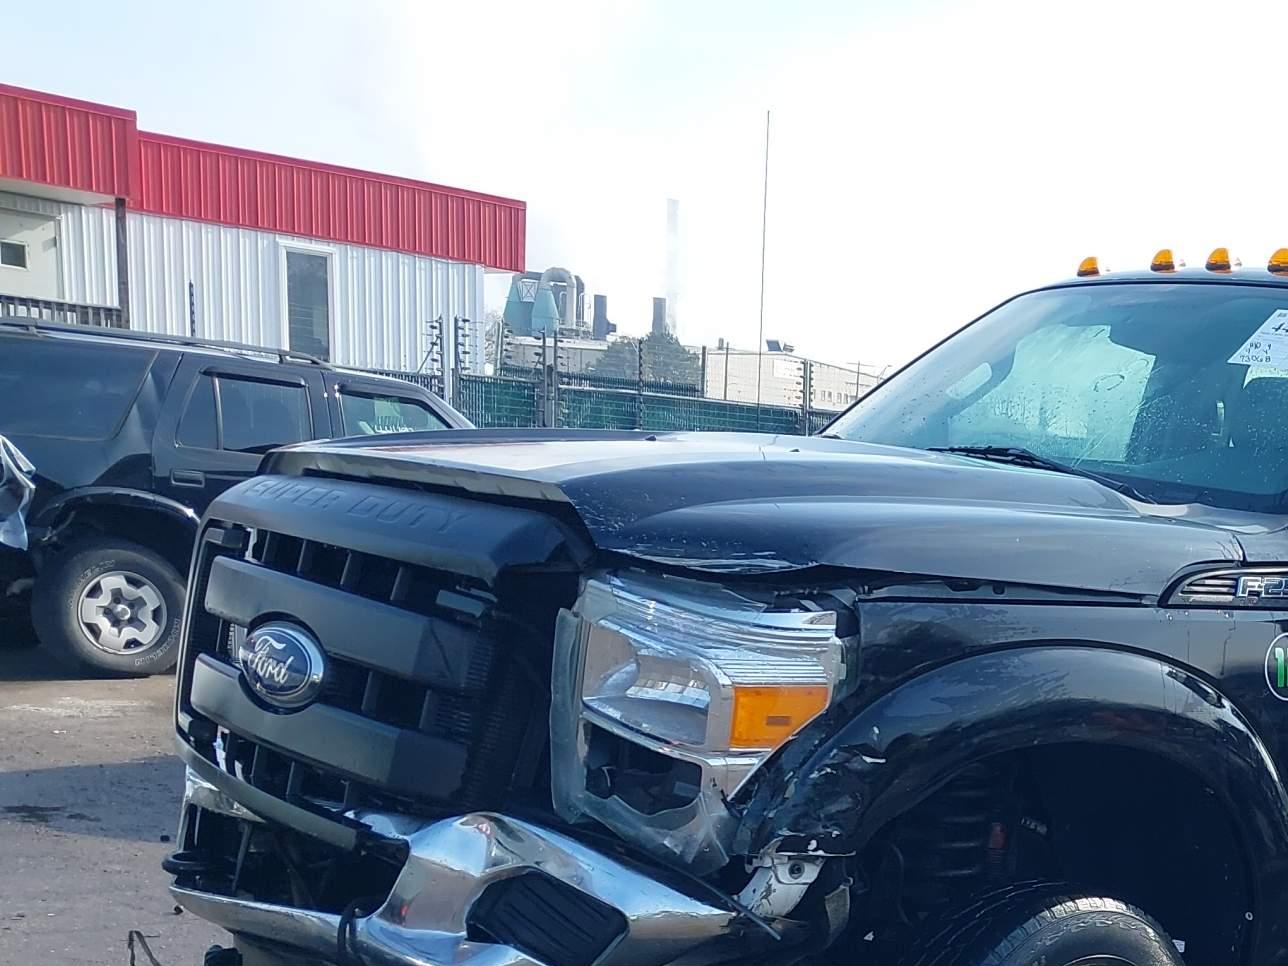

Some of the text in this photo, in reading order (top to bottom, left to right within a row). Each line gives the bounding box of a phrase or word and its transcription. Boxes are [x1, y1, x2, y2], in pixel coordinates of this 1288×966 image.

[243, 480, 472, 534] SUPER DUTY
[247, 634, 290, 687] Ford
